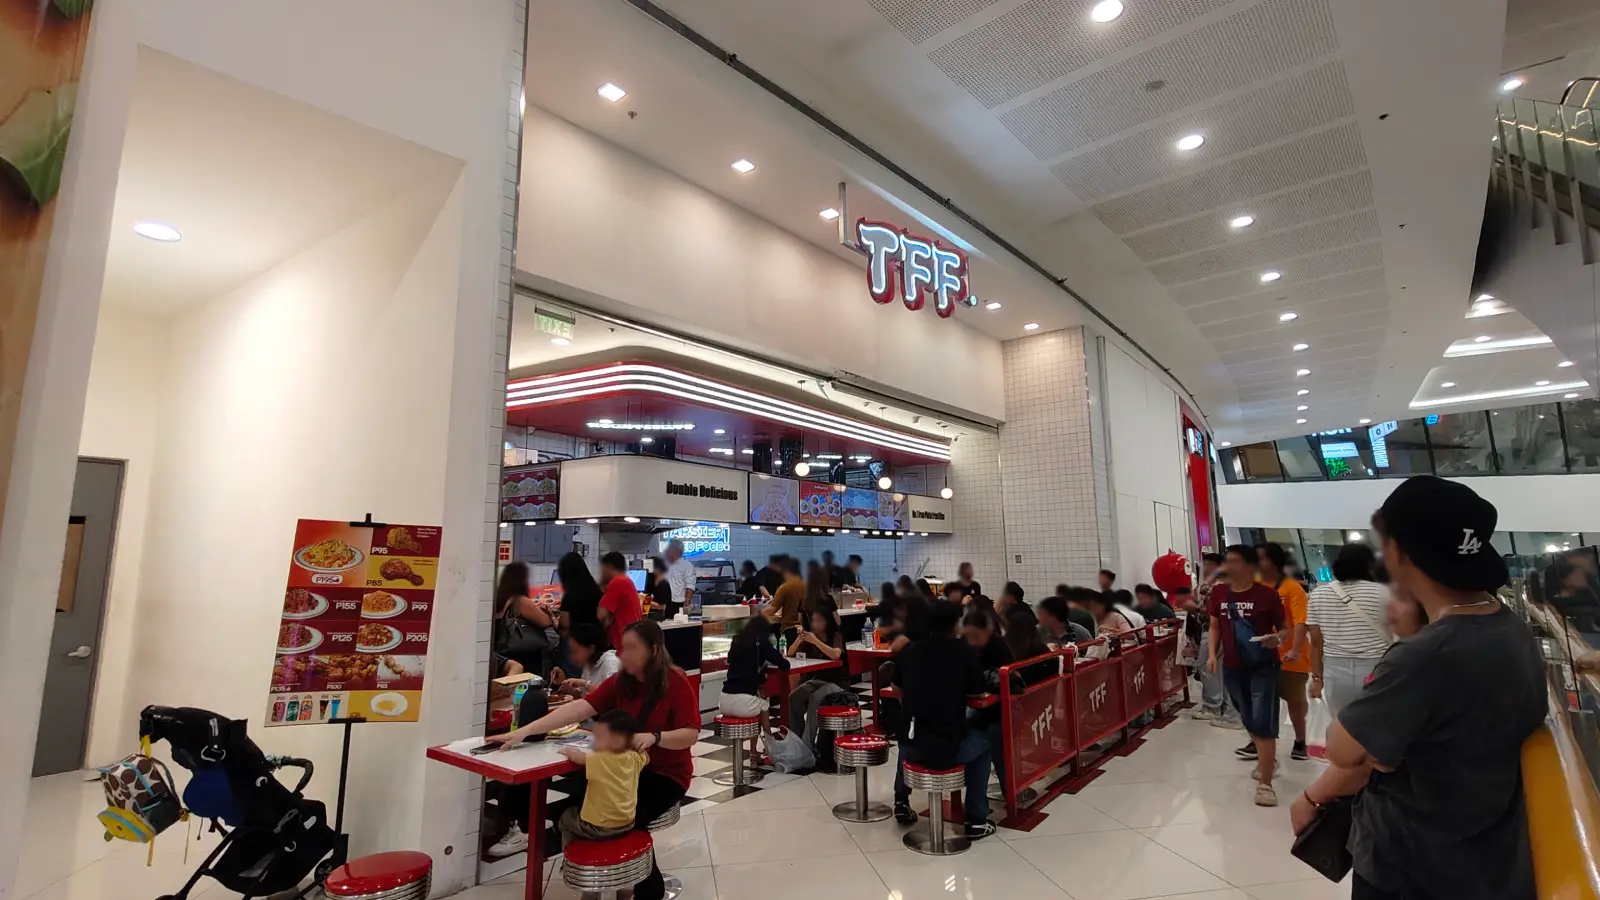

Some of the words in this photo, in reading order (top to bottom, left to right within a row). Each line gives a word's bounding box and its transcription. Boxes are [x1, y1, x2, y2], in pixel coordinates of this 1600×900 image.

[666, 481, 698, 497] Double
[700, 485, 738, 501] Delicious
[1458, 528, 1482, 555] LA
[366, 579, 383, 587] P85
[335, 602, 357, 610] P155
[1220, 602, 1254, 610] BOTON
[331, 634, 353, 642] P125
[405, 634, 428, 642] P205
[1133, 665, 1145, 694] TFF
[1089, 682, 1107, 712] TFF
[1031, 703, 1053, 746] TFF
